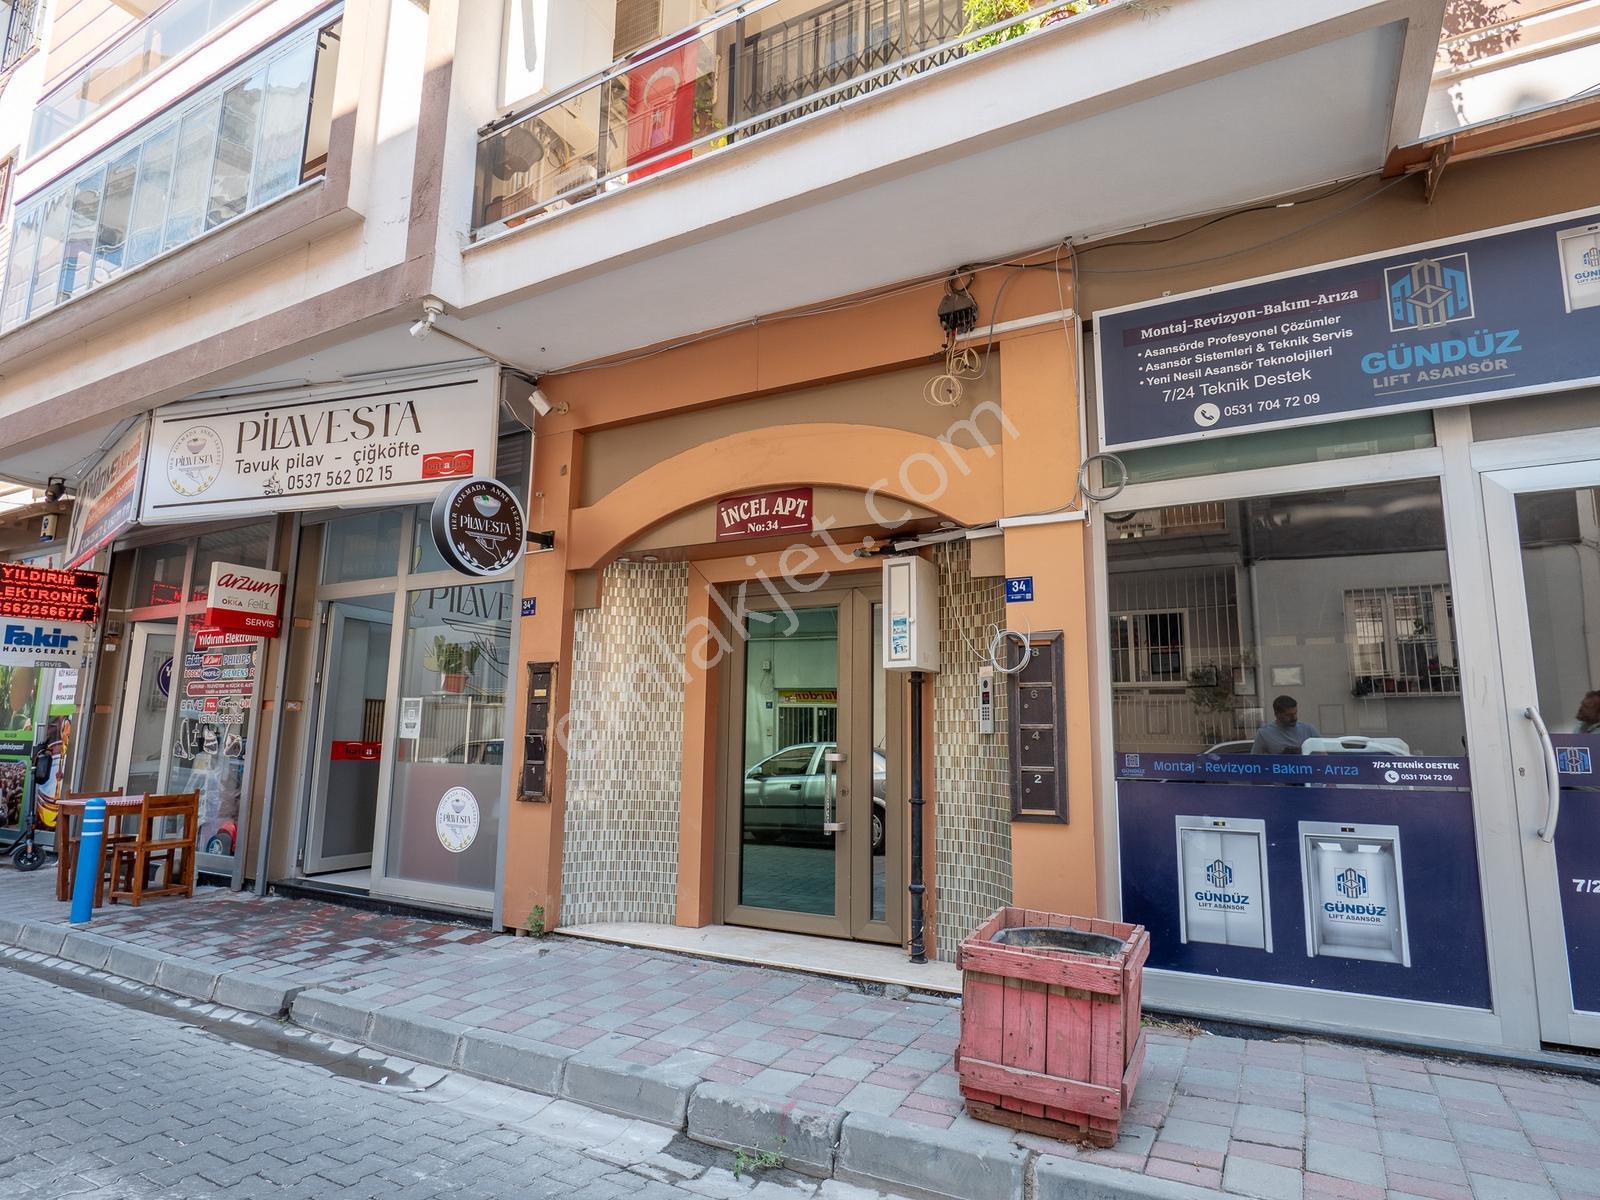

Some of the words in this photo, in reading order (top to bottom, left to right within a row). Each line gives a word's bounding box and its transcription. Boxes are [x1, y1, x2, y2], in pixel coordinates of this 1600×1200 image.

[1140, 288, 1358, 340] Montaj-Revizyon-Bakım-Arıza
[1144, 340, 1205, 358] Asansörde
[1207, 325, 1278, 347] Profesyonel
[1281, 315, 1341, 335] Çözümler
[1145, 354, 1192, 373] Asansör
[1194, 345, 1253, 364] Sistemleri
[1256, 342, 1265, 353] &
[1268, 335, 1309, 351] Teknik
[1312, 328, 1354, 343] Servis
[1361, 328, 1523, 375] GÜNDÜZ
[1146, 374, 1171, 387] Yeni
[1173, 369, 1202, 382] Nesil
[1204, 360, 1254, 377] Asansör
[1256, 346, 1333, 368] Teknolojileri
[1373, 373, 1411, 389] LIFT
[1416, 358, 1509, 383] ASANSÖR
[1162, 386, 1196, 403] 7/24
[1199, 378, 1250, 396] Teknik
[1254, 368, 1312, 388] Destek
[1224, 403, 1254, 417] 0531
[1257, 399, 1281, 412] 704
[1284, 395, 1300, 407] 72
[1303, 393, 1321, 404] 09
[237, 400, 422, 454] PİLAVESTA
[235, 456, 280, 475] Tavuk
[286, 453, 324, 475] pilav
[353, 442, 420, 465] çiğköfte
[287, 473, 321, 491] 0537
[326, 469, 351, 487] 562
[356, 467, 374, 483] 02
[379, 465, 393, 481] 15
[455, 484, 487, 508] LOKMADA
[460, 513, 512, 536] PİLAVESTA
[720, 498, 770, 528] İNCEL
[772, 497, 808, 519] APT.
[3, 567, 76, 585] YILDIRIM
[217, 573, 279, 597] arzum
[1012, 580, 1026, 592] 34
[0, 602, 84, 619] 562256677
[245, 617, 275, 628] SERVİS
[4, 624, 79, 649] Fakir
[1031, 689, 1038, 699] 6
[1032, 731, 1040, 740] 4
[1153, 760, 1195, 774] Montaj
[1205, 762, 1262, 775] Revizyon
[1272, 763, 1313, 775] Bakım
[1324, 764, 1360, 776] Arıza
[1372, 761, 1391, 769] 7/24
[1391, 760, 1424, 769] TEKNİK
[1425, 762, 1460, 770] DESTEK
[1400, 773, 1418, 781] 0531
[1419, 773, 1432, 781] 704
[1034, 774, 1042, 784] 2
[1195, 889, 1249, 905] GÜNDÜZ
[1324, 901, 1387, 917] GÜNDÜZ
